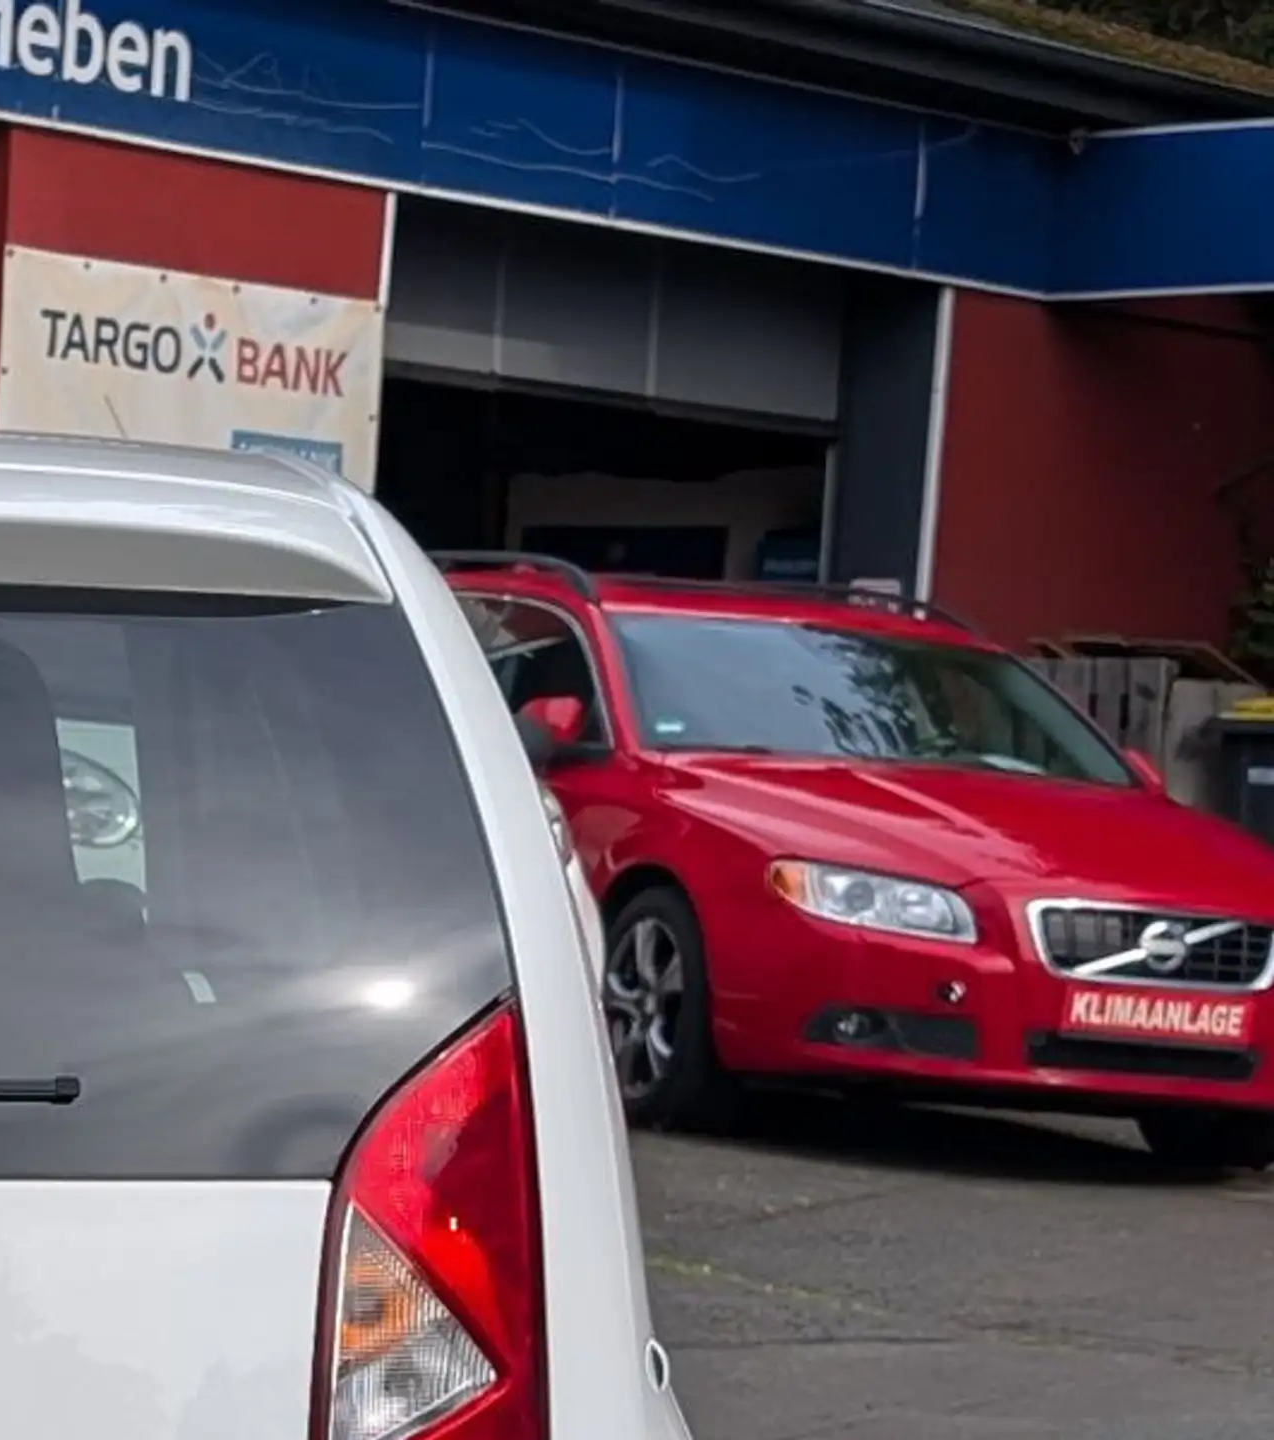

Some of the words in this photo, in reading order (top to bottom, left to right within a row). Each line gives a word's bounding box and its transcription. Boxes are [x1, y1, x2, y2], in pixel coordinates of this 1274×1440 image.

[41, 309, 181, 374] TARGO
[236, 337, 349, 397] BANK
[1071, 992, 1244, 1037] KLIMAANLAGE
